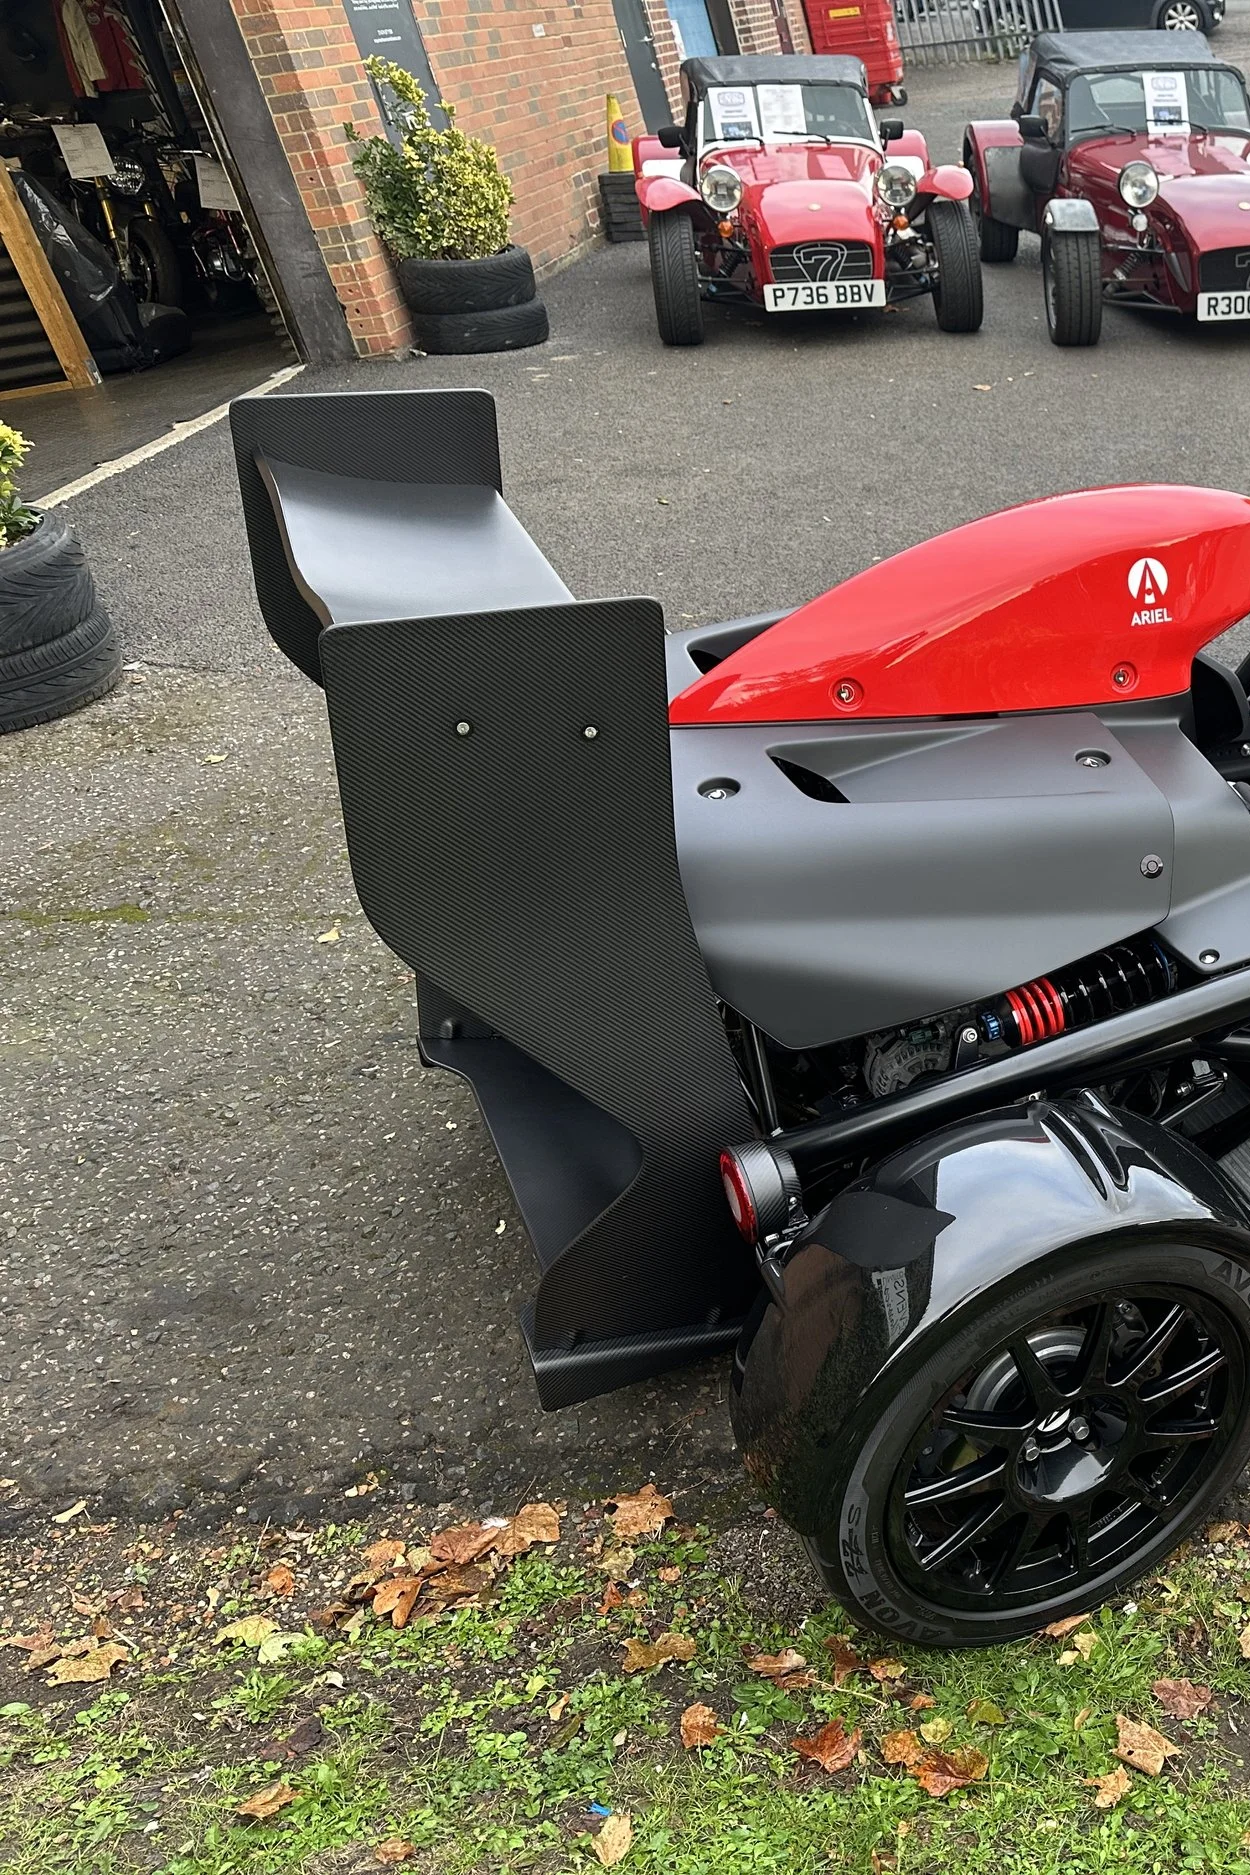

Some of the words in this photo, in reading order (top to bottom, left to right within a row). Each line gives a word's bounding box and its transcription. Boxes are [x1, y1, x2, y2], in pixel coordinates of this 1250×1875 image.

[772, 286, 829, 307] P736
[834, 283, 875, 304] BBV
[1130, 607, 1173, 627] ARIEL
[858, 1589, 947, 1641] AVON
